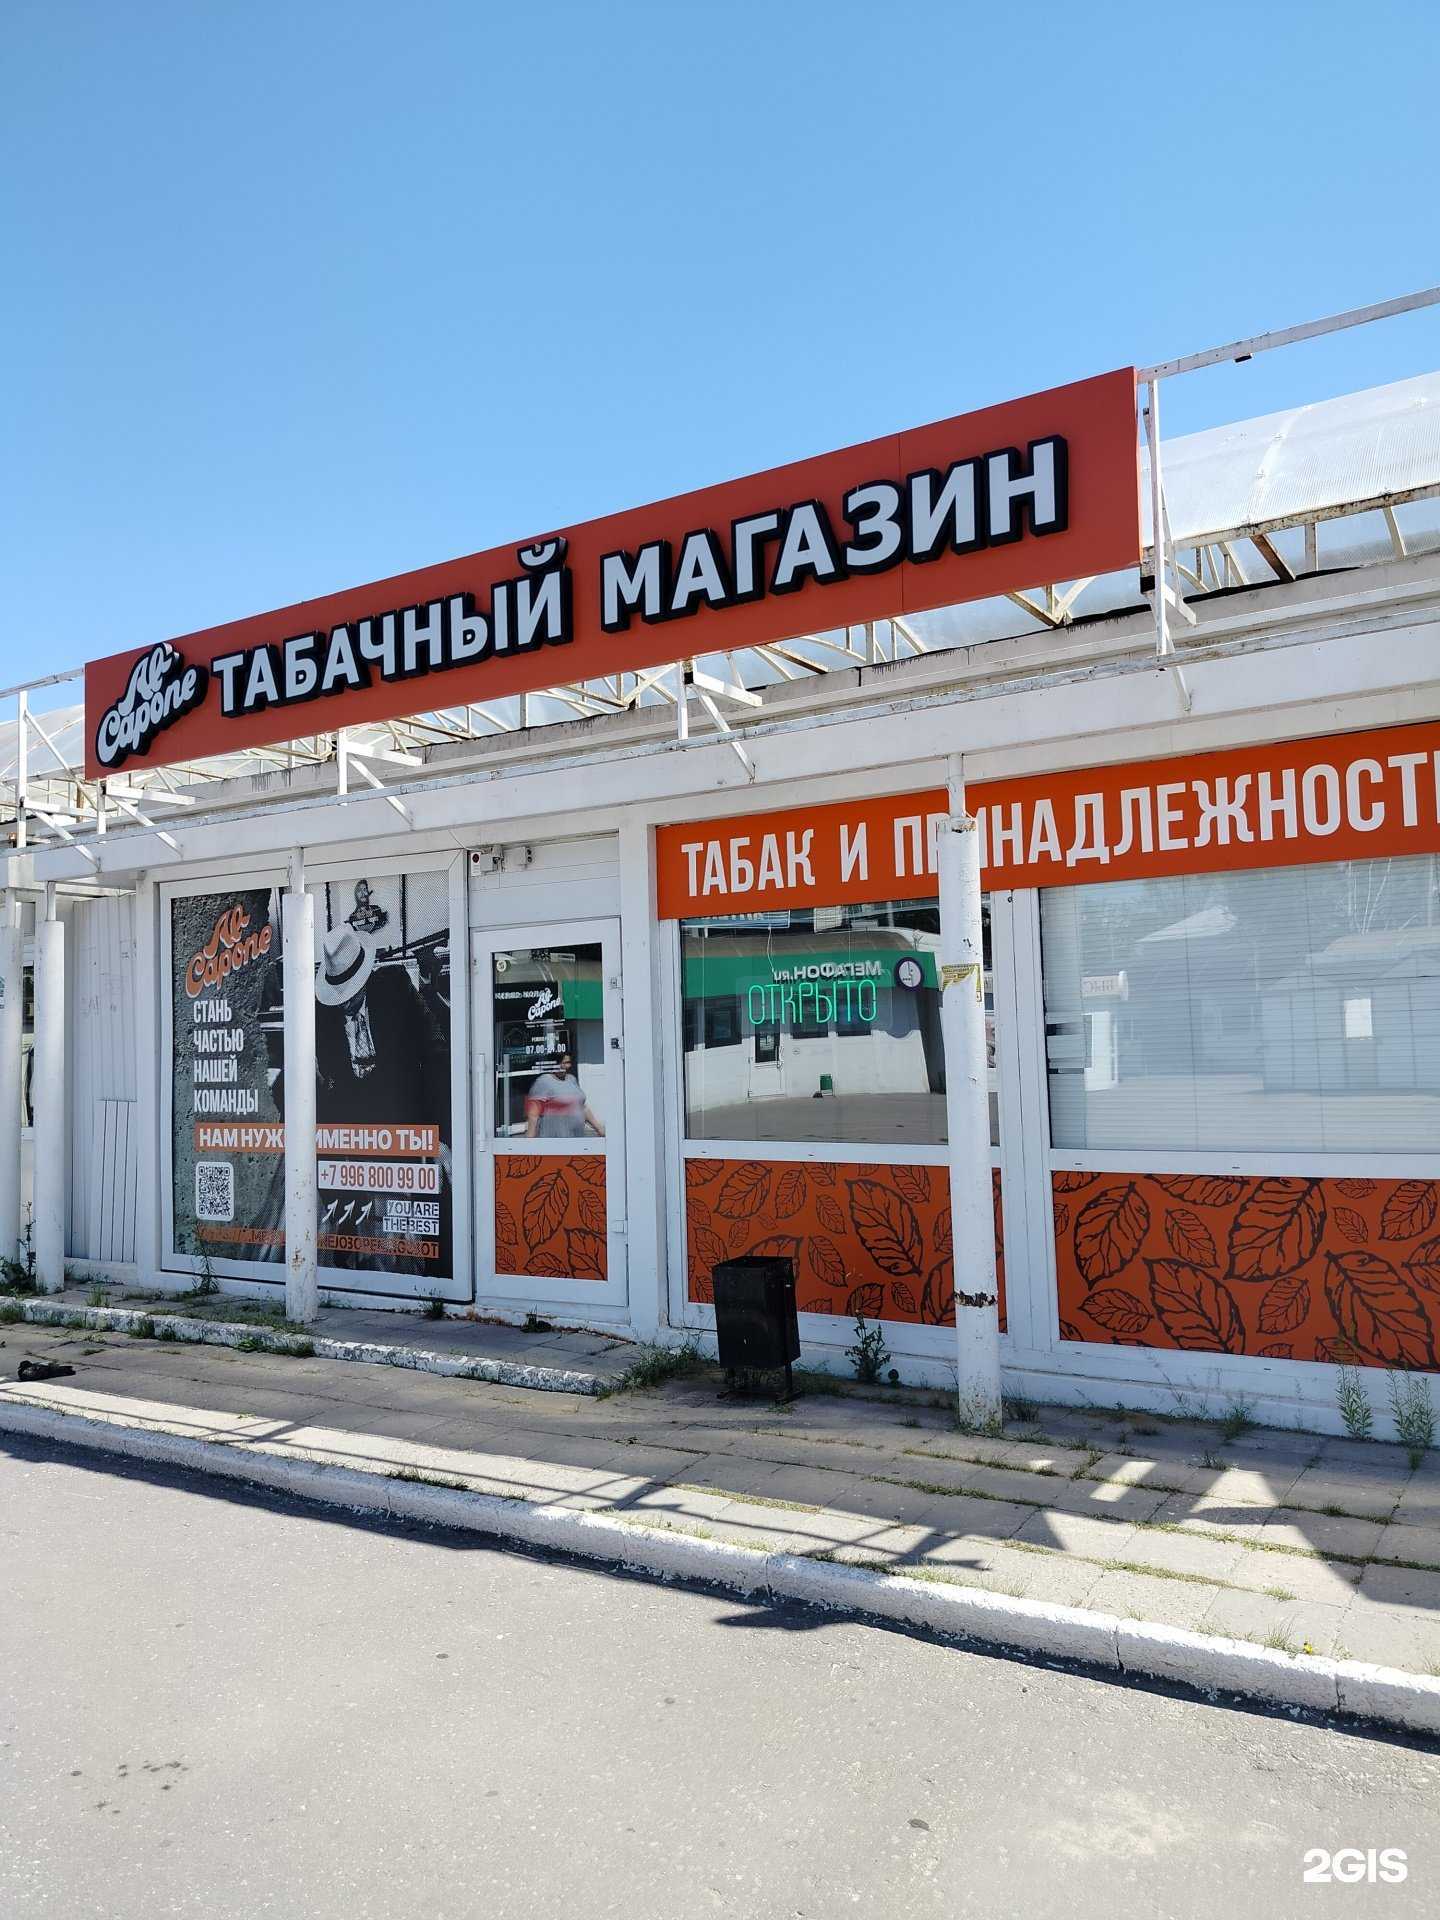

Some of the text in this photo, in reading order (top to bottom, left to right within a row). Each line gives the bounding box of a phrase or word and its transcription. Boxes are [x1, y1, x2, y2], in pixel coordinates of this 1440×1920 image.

[212, 441, 1058, 714] ТАБАЧНЫЙ МАГАЗИН
[118, 646, 173, 716] Al
[98, 668, 197, 763] Capone
[681, 750, 1440, 897] ТАБАК И ПРНАДЛЕЖНОСТ
[203, 904, 251, 959] Al
[186, 924, 273, 998] Capone
[193, 999, 233, 1024] СТАНЬ
[748, 979, 877, 1025] ОТКРЫТО
[193, 1028, 245, 1053] ЧАСТЬЮ
[193, 1054, 239, 1083] НАШЕЙ
[193, 1088, 259, 1115] КОМАНДЫ
[199, 1127, 238, 1148] НАМ
[241, 1128, 285, 1148] НУЖ
[396, 1129, 433, 1151] ТЫ!
[320, 1164, 436, 1191] +7 996 800 99 00
[387, 1200, 440, 1218] YOU ARE
[383, 1217, 439, 1235] THE BEST
